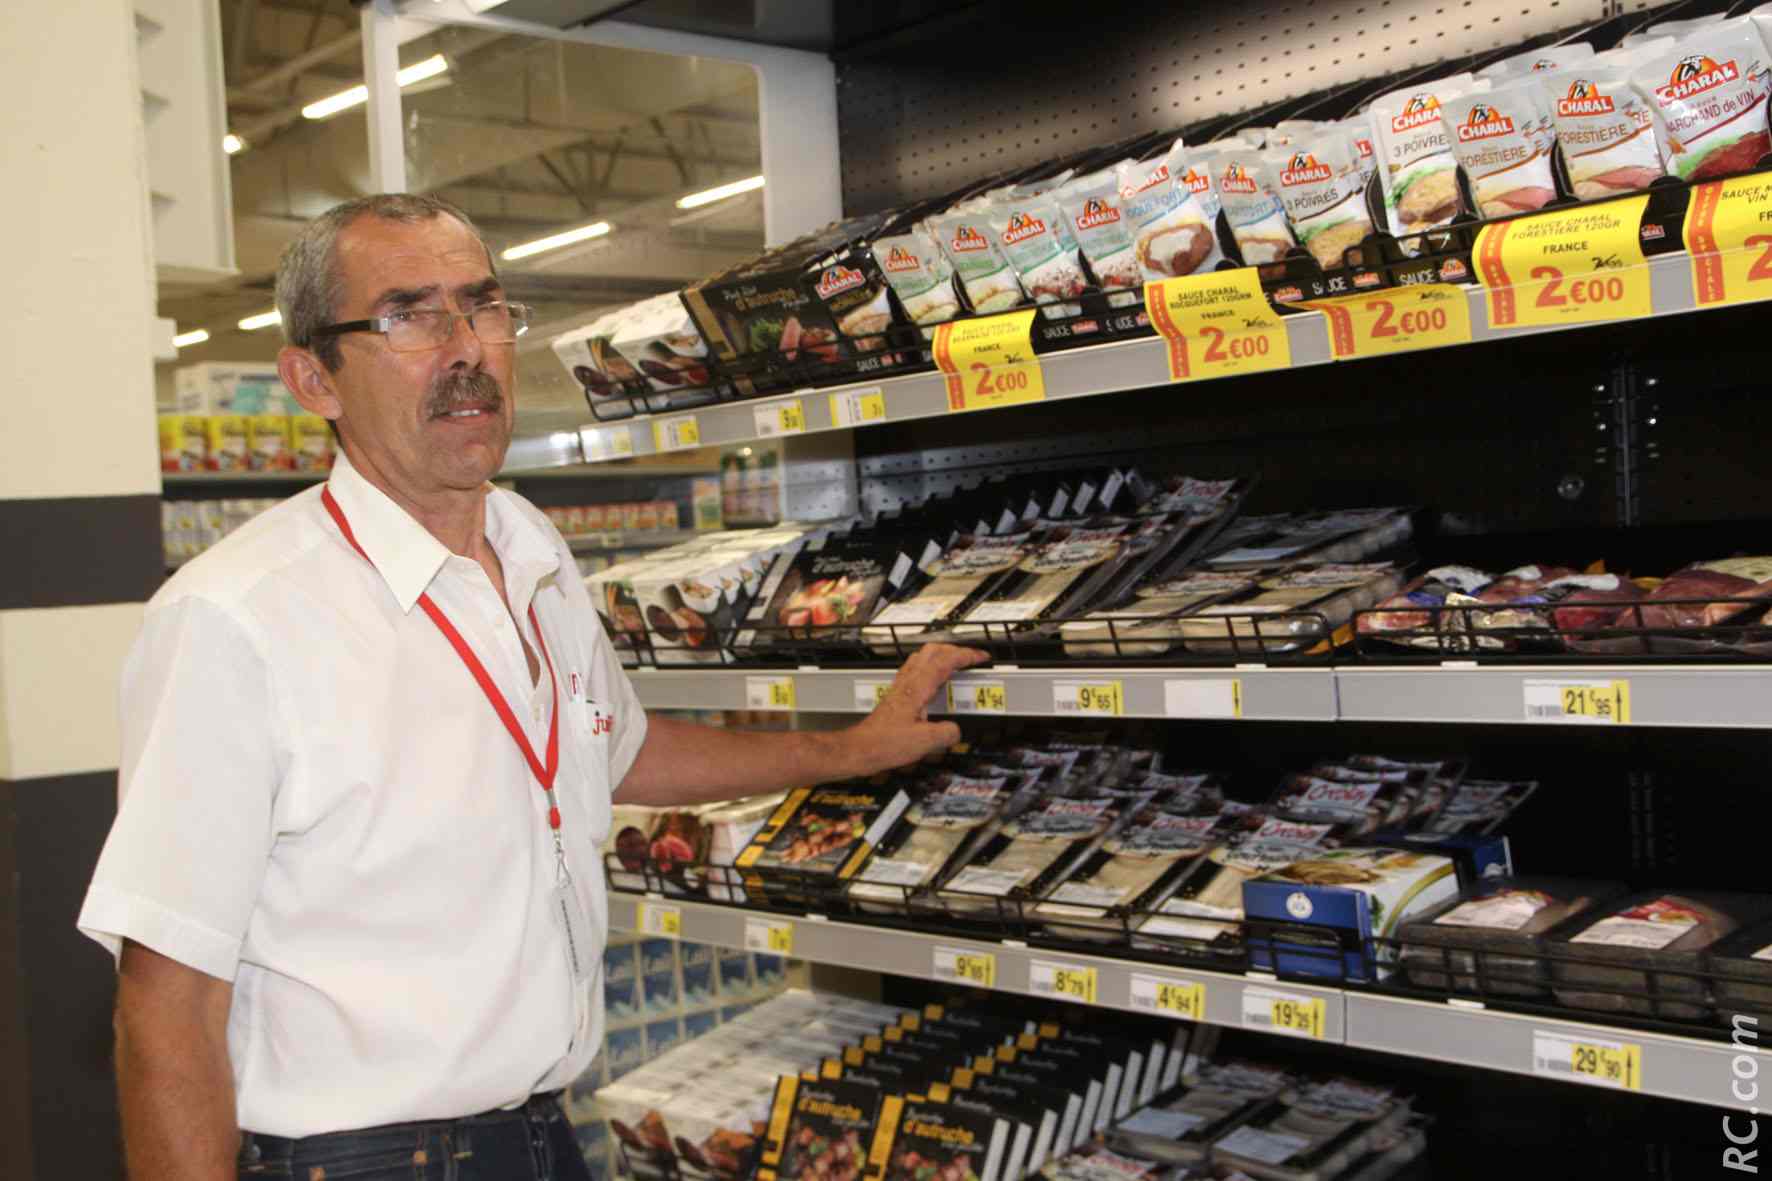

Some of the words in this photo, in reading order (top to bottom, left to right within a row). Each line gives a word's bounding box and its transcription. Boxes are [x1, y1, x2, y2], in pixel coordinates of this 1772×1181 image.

[1656, 61, 1736, 101] CHARAL
[1558, 100, 1612, 116] CHARAL
[1459, 122, 1513, 141] CHARAL
[1280, 166, 1331, 186] CHARAL
[1543, 241, 1588, 254] FRANCE
[1530, 266, 1624, 309] 2€00
[1365, 300, 1447, 338] 2€00
[1199, 326, 1269, 363] 2€00
[970, 362, 1029, 396] 2€00
